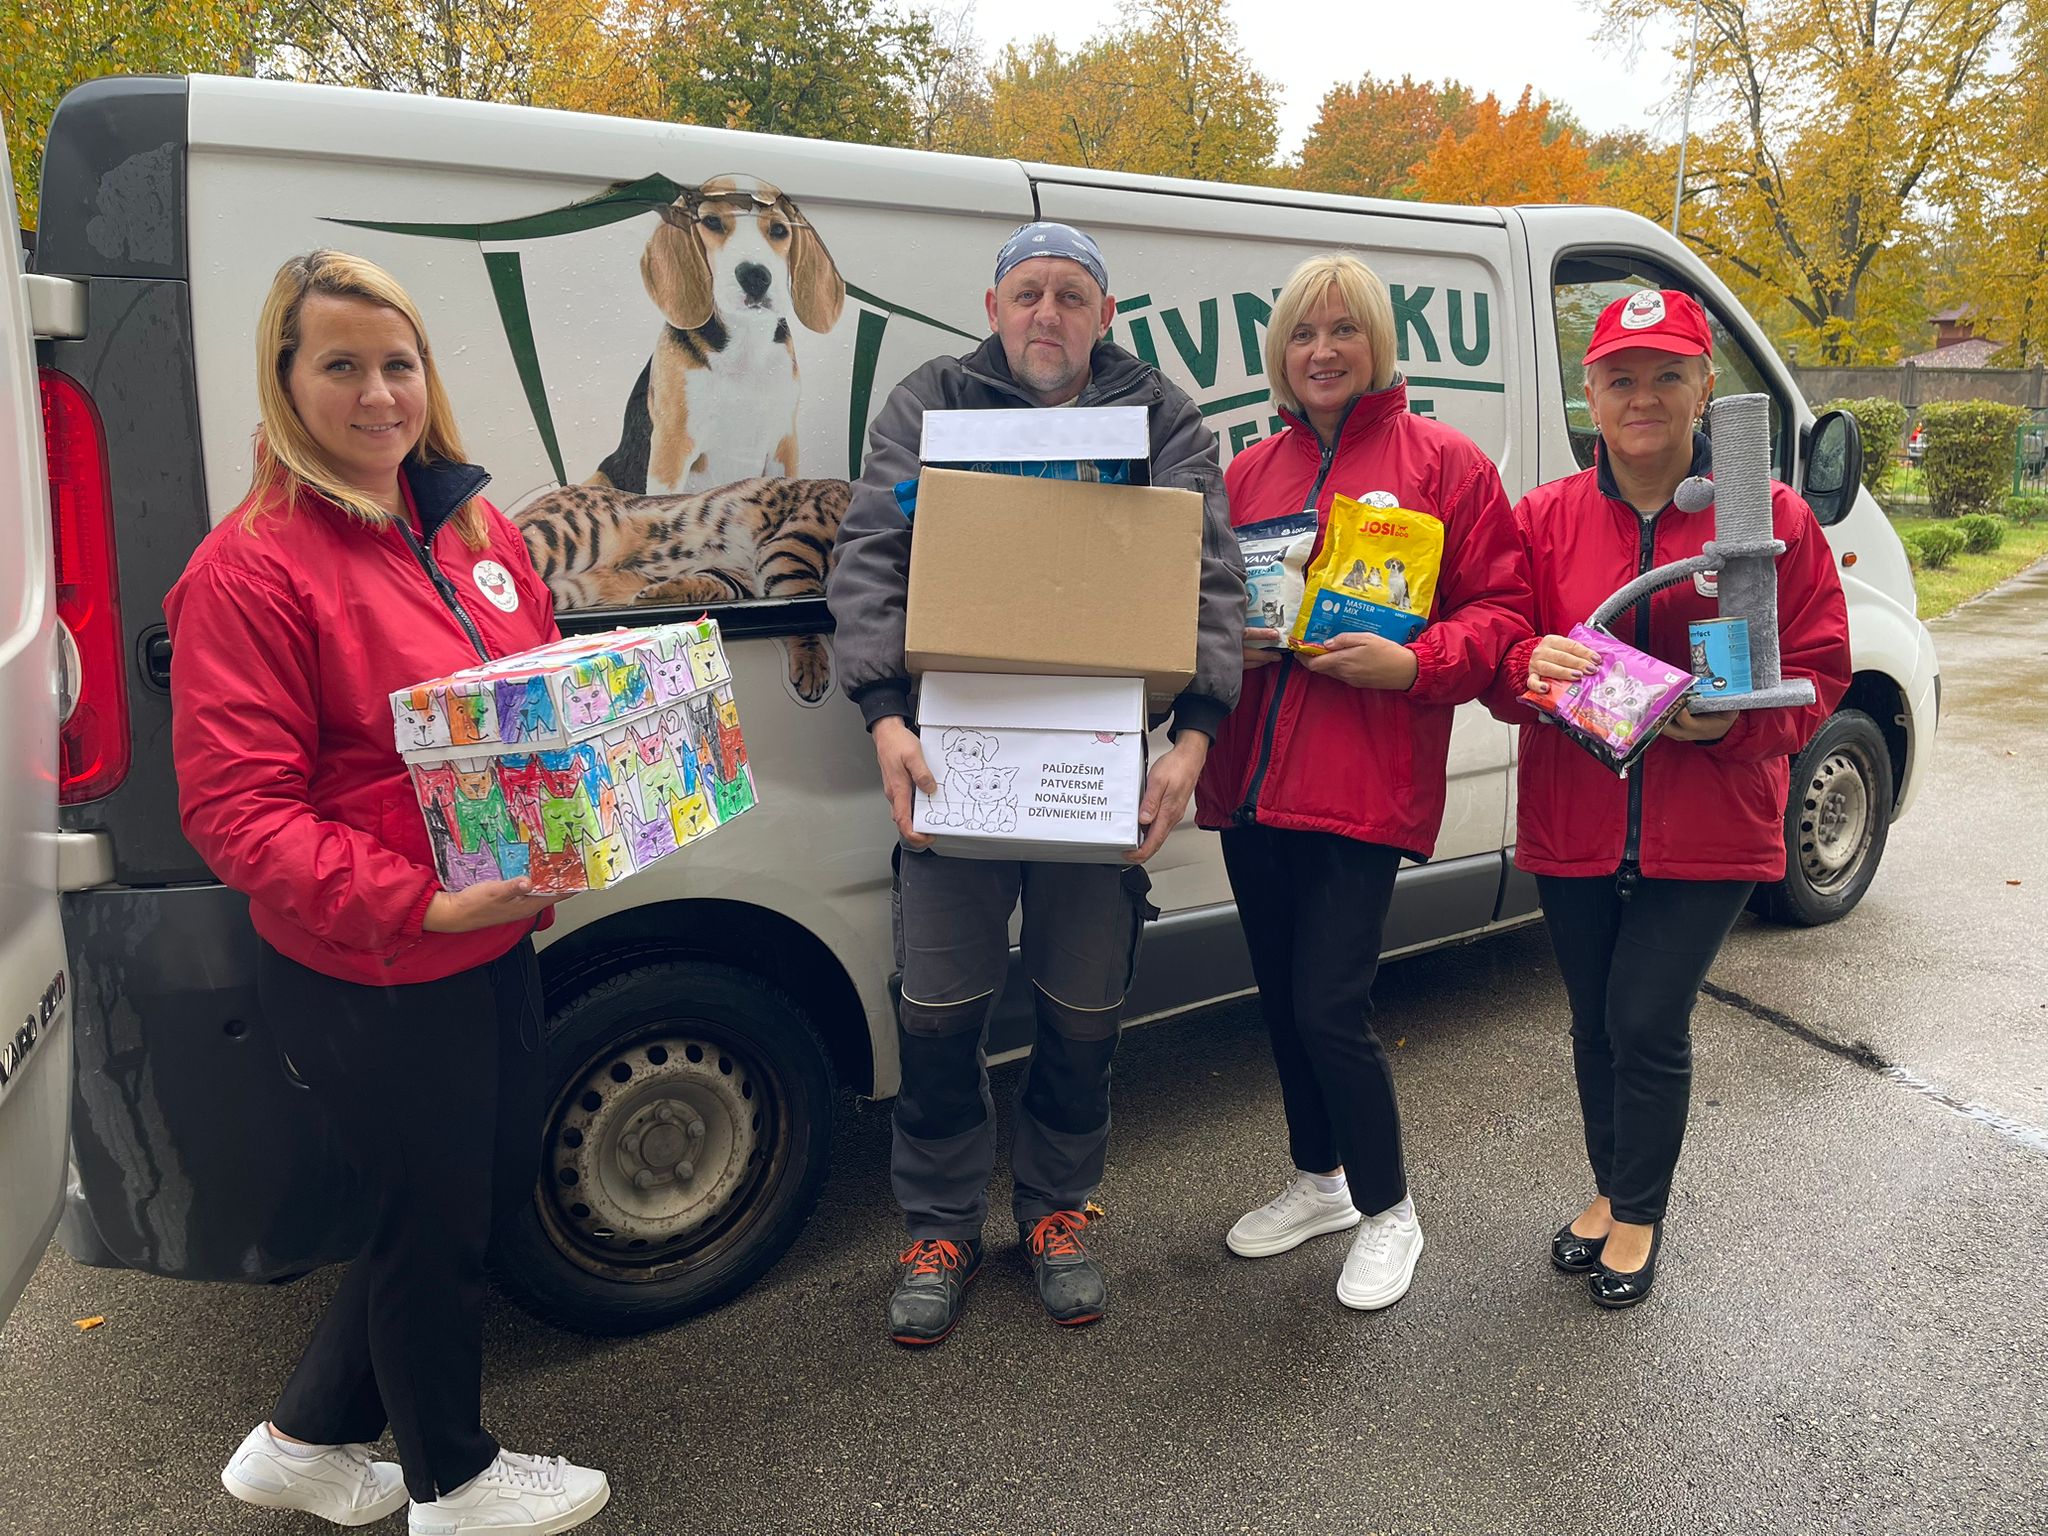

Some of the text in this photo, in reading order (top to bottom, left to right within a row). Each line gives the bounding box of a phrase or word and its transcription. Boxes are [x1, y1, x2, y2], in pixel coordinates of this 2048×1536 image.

[1359, 521, 1396, 536] JOSI
[1343, 606, 1360, 616] MIX
[1345, 599, 1376, 613] MASTER
[1042, 762, 1105, 776] PALĪDZĒSIM
[1040, 778, 1104, 791] PATVERSMĒ
[1034, 792, 1108, 806] NONĀKUŠIEM
[1028, 806, 1112, 821] DZĪVNIEKIEM !!!
